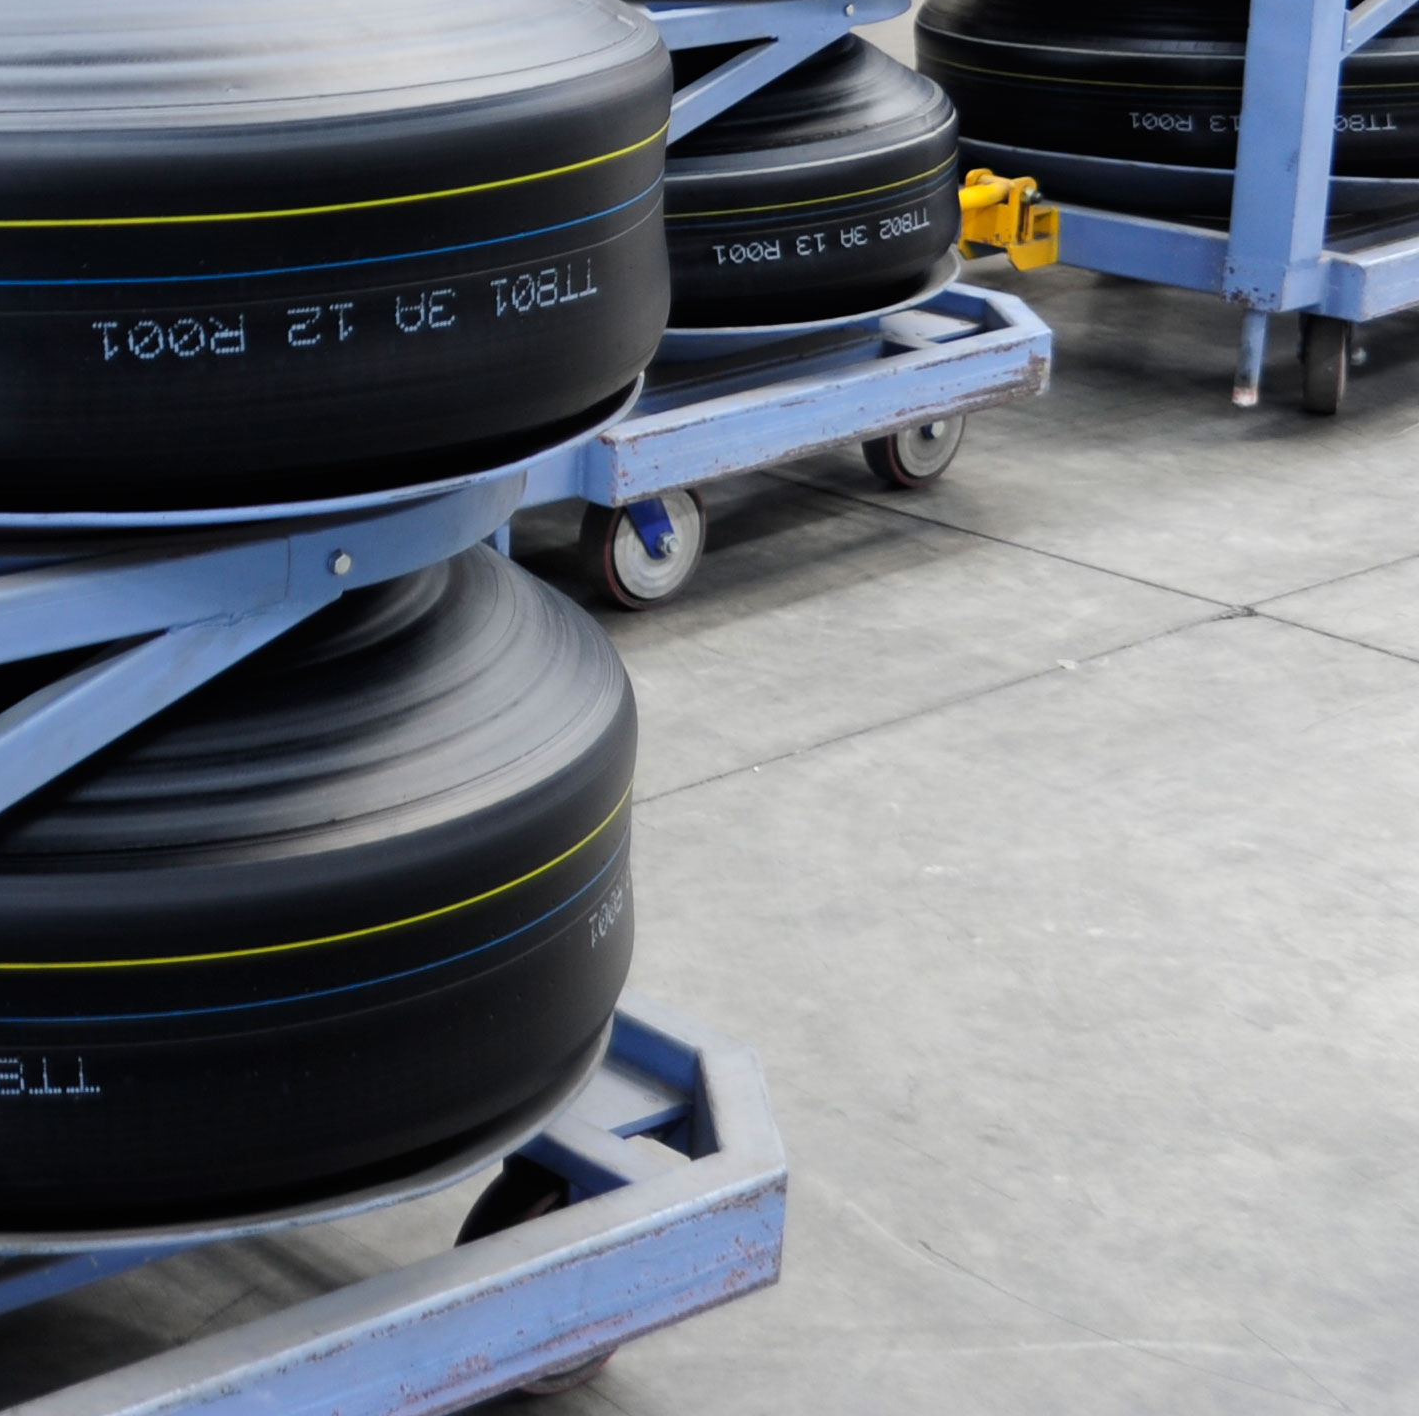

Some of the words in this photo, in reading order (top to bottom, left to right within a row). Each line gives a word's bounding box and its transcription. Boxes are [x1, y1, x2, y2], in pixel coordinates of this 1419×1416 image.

[1128, 112, 1192, 133] R001
[1333, 112, 1397, 131] TT80
[840, 225, 868, 248] 3A
[879, 208, 931, 241] TT802
[713, 239, 781, 266] R001
[796, 232, 826, 257] 13
[490, 257, 598, 318] TT801
[286, 301, 356, 347] 12
[395, 287, 456, 333] 3A
[92, 313, 245, 361] R001
